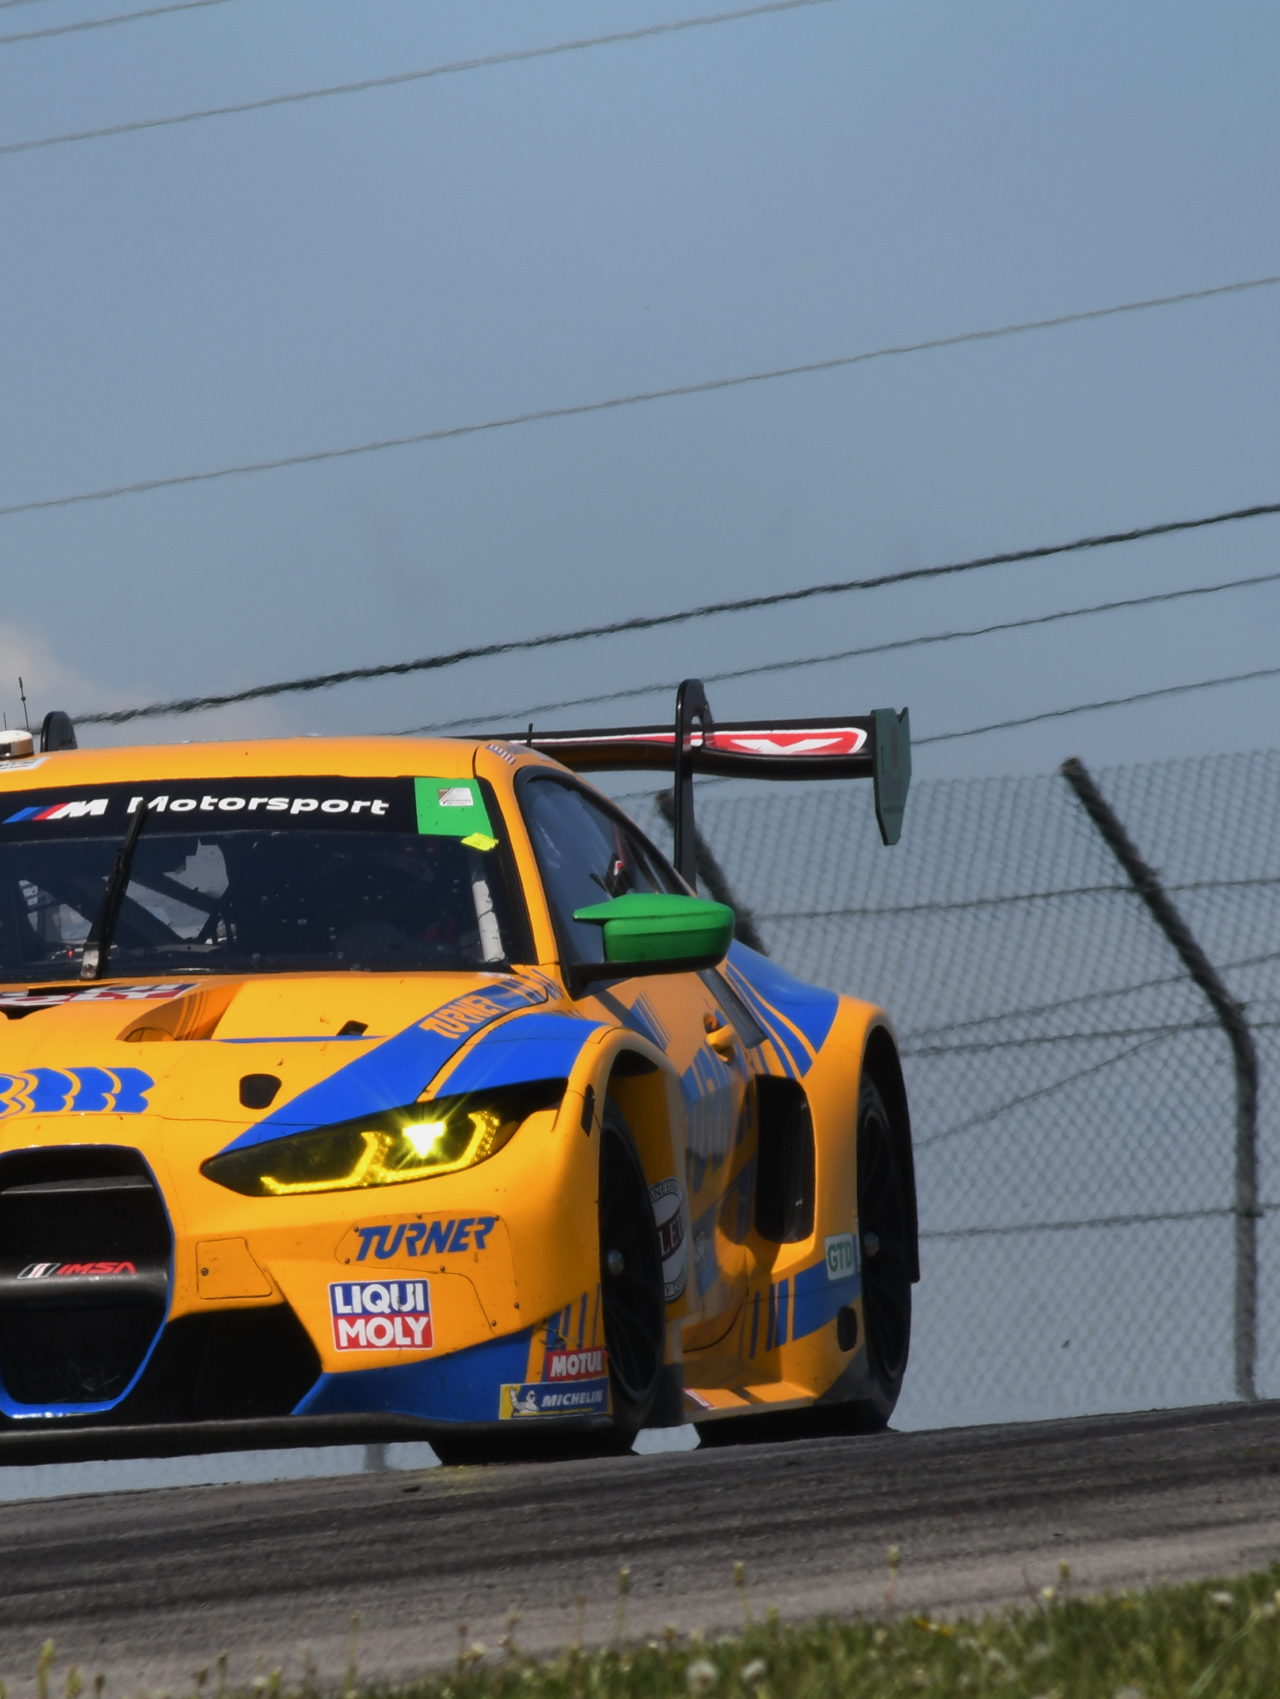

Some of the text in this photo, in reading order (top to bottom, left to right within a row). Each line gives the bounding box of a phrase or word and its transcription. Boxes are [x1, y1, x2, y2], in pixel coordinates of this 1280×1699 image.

[127, 796, 389, 815] Motorsport
[419, 994, 509, 1039] TURNER
[356, 1216, 496, 1261] TURNER
[335, 1283, 426, 1313] LIQUI
[337, 1316, 428, 1347] MOLY
[550, 1350, 603, 1378] MOTUL
[541, 1390, 603, 1408] MICHELIN
